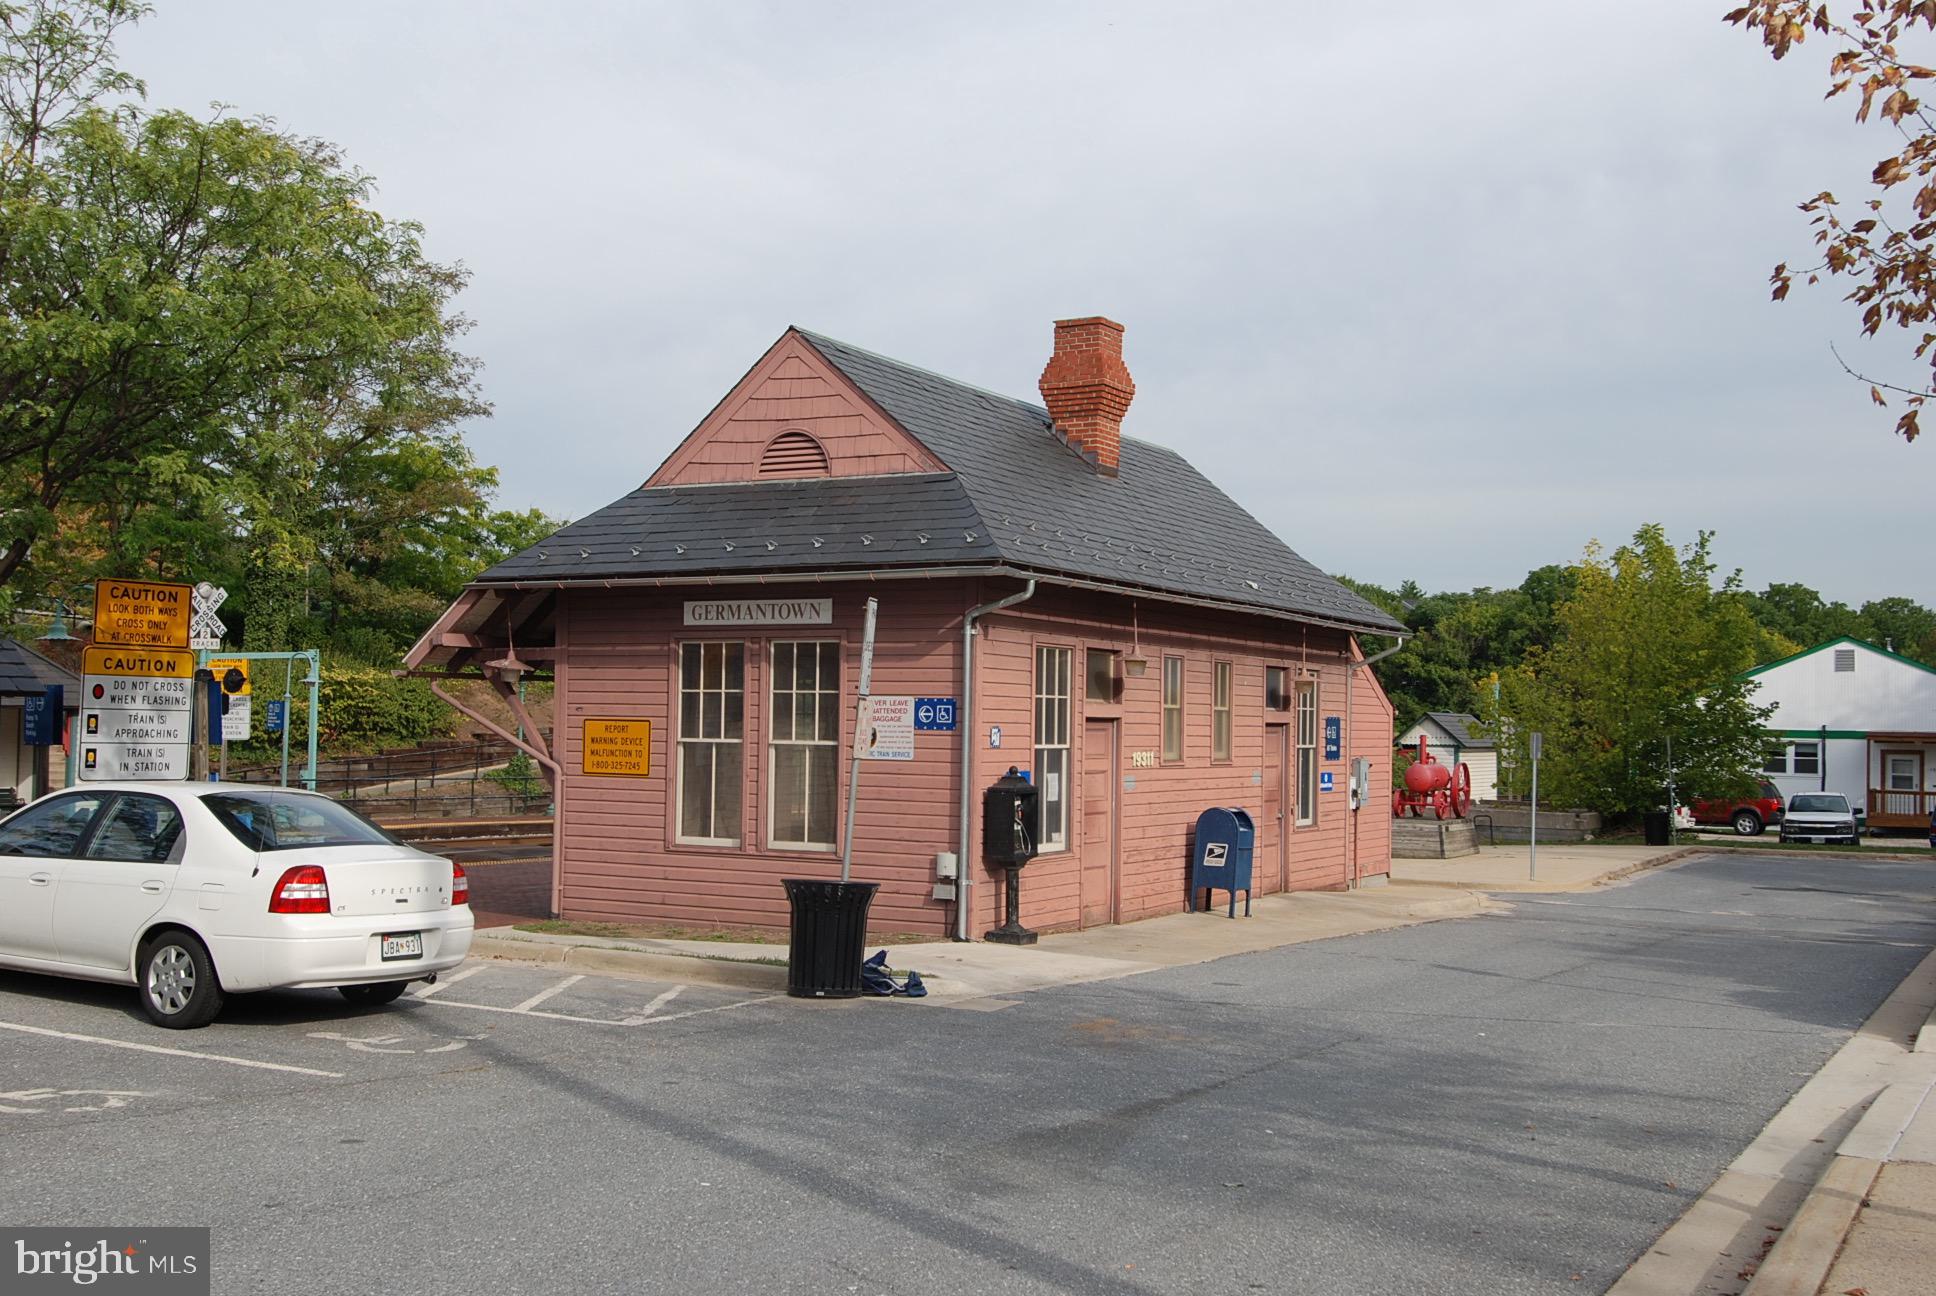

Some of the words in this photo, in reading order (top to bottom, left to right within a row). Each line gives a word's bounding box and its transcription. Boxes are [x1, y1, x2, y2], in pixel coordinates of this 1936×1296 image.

[110, 586, 178, 603] CAUTION
[108, 604, 130, 614] LOOK
[133, 605, 154, 615] BOTH
[158, 606, 178, 617] WAYS
[190, 592, 224, 633] CROSSING
[691, 602, 822, 621] GERMANTOWN
[116, 617, 144, 629] CROSS
[147, 619, 168, 630] ONLY
[111, 631, 122, 641] AT
[124, 632, 172, 645] CROSSWALK
[203, 630, 208, 639] 2
[103, 657, 177, 672] CAUTION
[113, 680, 126, 690] DO
[131, 681, 149, 691] NOT
[154, 681, 184, 692] CROSS
[110, 694, 137, 705] WHEN
[142, 695, 187, 706] FLASHING
[128, 714, 155, 724] TRAIN
[157, 714, 167, 725] (S)
[114, 728, 178, 739] APPROACHING
[604, 724, 629, 733] REPORT
[590, 737, 618, 745] WARNING
[620, 737, 643, 746] DEVICE
[126, 748, 152, 758] TRAIN
[155, 748, 165, 759] (S)
[590, 749, 632, 757] MALFUNCTION
[635, 750, 643, 758] TO
[1132, 751, 1154, 768] 19311
[120, 762, 129, 772] IN
[134, 762, 170, 772] STATION
[371, 887, 429, 896] SPECTRA
[384, 941, 400, 955] JBA
[405, 939, 420, 953] 931
